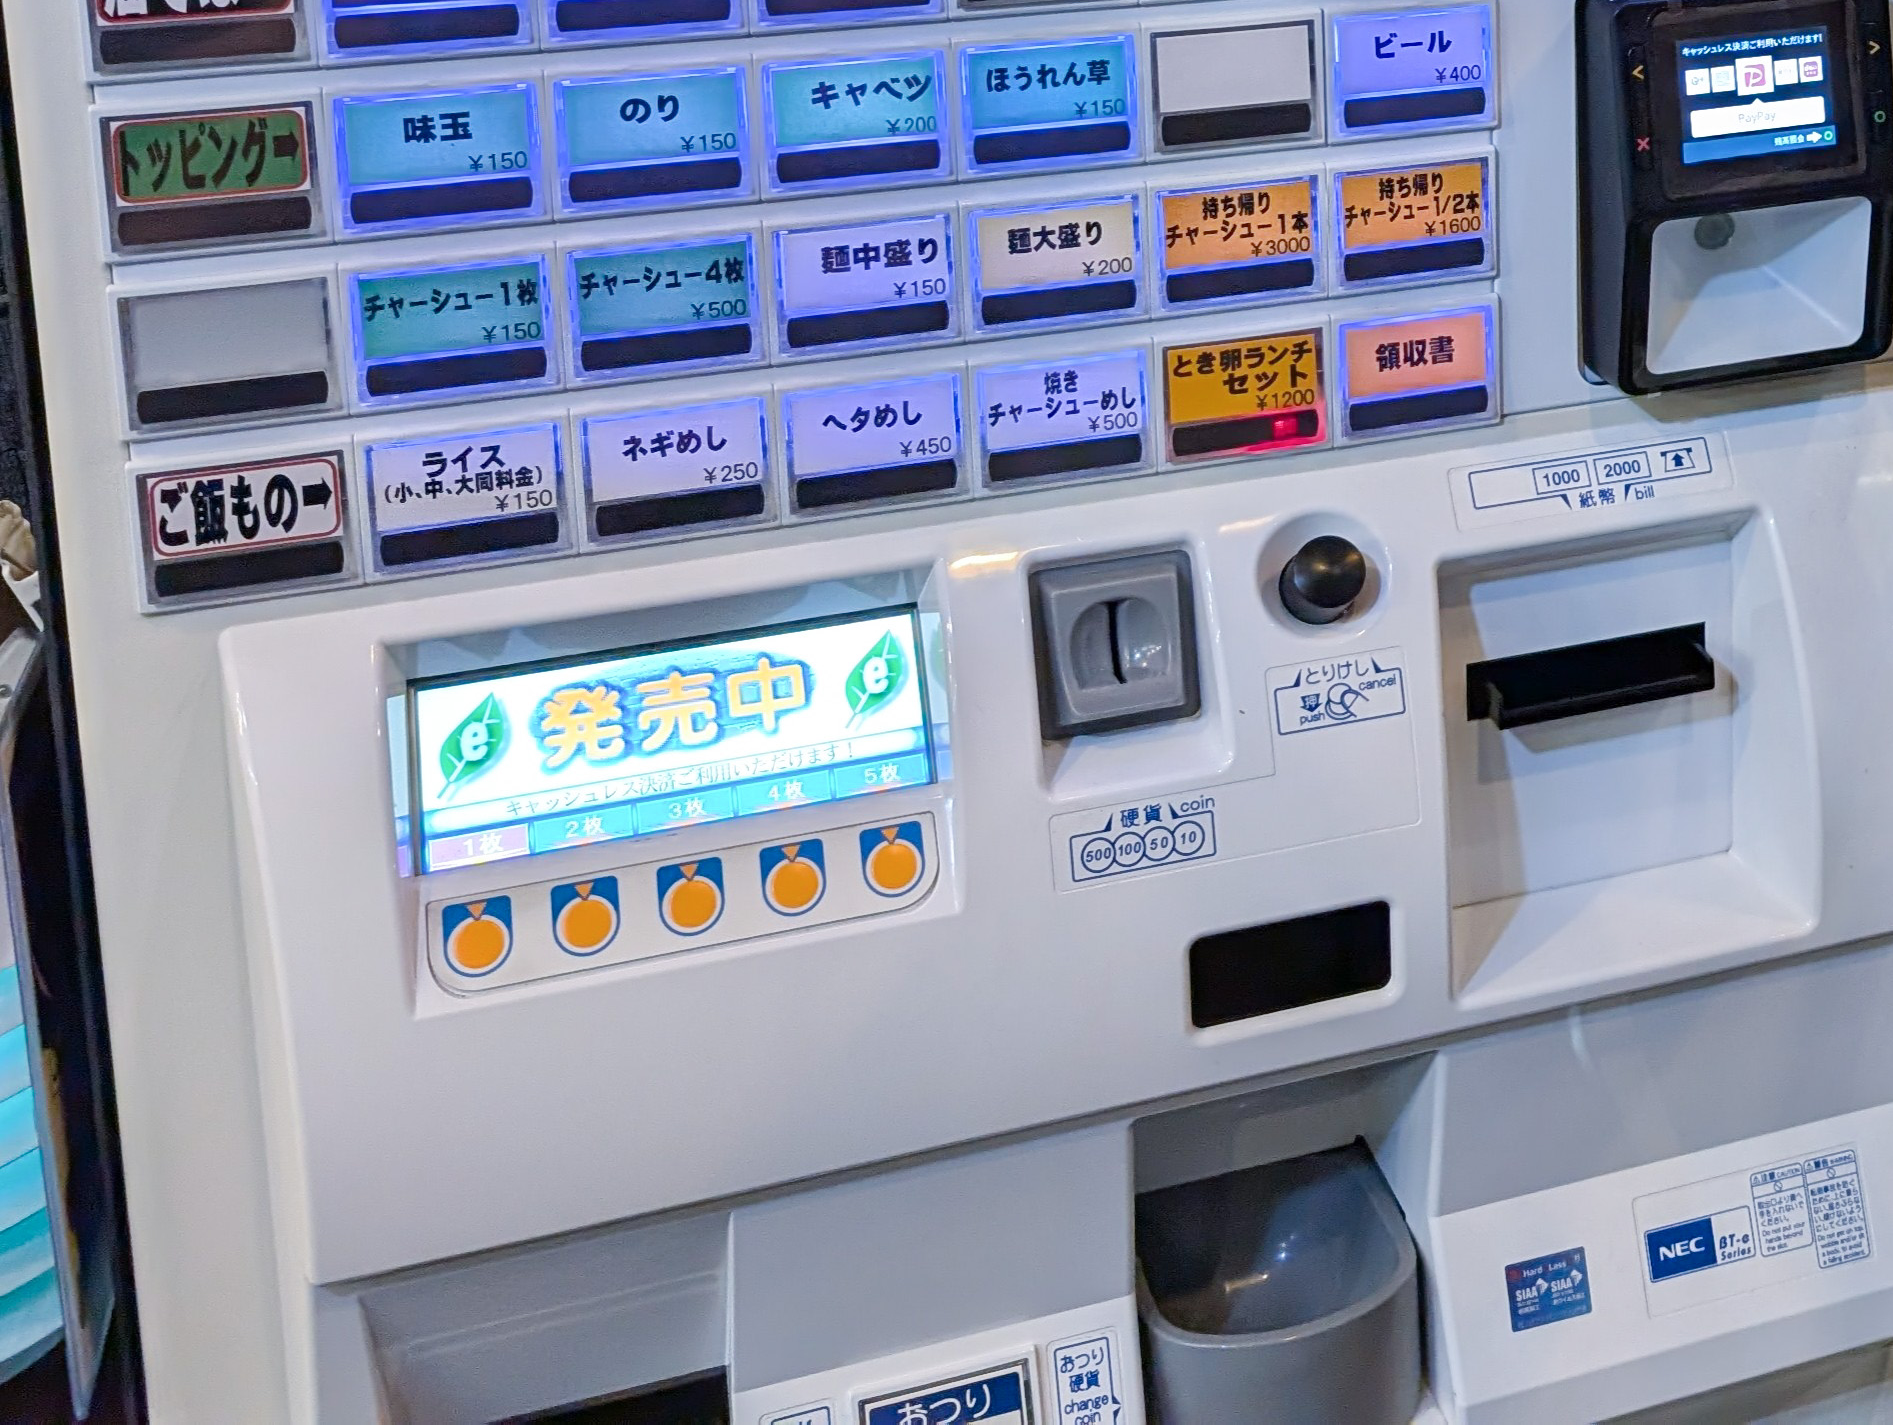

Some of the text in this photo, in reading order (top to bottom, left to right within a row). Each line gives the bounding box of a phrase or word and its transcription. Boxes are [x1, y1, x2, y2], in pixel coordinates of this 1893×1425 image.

[1374, 30, 1452, 59] ビール
[986, 59, 1111, 93] ほうれん草
[1435, 65, 1481, 84] ¥400
[811, 73, 932, 110] キャベツ
[619, 93, 680, 124] のり
[1738, 111, 1776, 124] PayPay
[402, 111, 474, 144] 味玉
[886, 115, 936, 136] ¥200
[119, 117, 268, 196] トッピング
[1378, 172, 1444, 201] 持ち帰り
[1344, 190, 1481, 229] チャーシュー1/2本
[1006, 220, 1103, 255] 麺大盛り
[1165, 211, 1309, 249] チャーシュー1本
[1424, 215, 1482, 237] ¥1600
[820, 238, 939, 275] 麺中盛り
[1250, 236, 1311, 257] ¥3000
[579, 256, 746, 299] チャーシュー4枚
[1081, 256, 1133, 277] ¥200
[363, 278, 538, 322] チャーシュー1枚
[893, 277, 946, 298] ¥150
[691, 298, 748, 320] ¥500
[1171, 339, 1313, 378] とき卵ランチ
[1375, 336, 1455, 372] 領収書
[1043, 369, 1079, 395] 焼き
[822, 399, 923, 433] ヘタめし
[988, 387, 1136, 428] チャーシューめし
[621, 424, 728, 460] ネギめし
[900, 436, 952, 458] ¥450
[421, 444, 506, 478] ライス
[703, 461, 758, 484] ¥250
[1542, 460, 1642, 486] 1000 2000
[1579, 486, 1616, 508] 紙幣
[1634, 485, 1655, 501] bill
[158, 473, 299, 548] ご飯もの
[1306, 659, 1369, 685] とりけし
[1359, 674, 1397, 691] cancel
[541, 657, 807, 770] 発売中
[1300, 711, 1325, 726] push
[505, 741, 855, 817] キャッシュレス決済ご利用いただけます！
[864, 762, 900, 784] 5枚
[768, 780, 805, 801] 4枚
[668, 798, 705, 819] 3枚
[1120, 803, 1162, 828] 硬貨
[1179, 795, 1215, 813] coin
[566, 815, 604, 838] 2枚
[463, 833, 504, 854] 1枚
[1086, 829, 1197, 862] 500 100 50 10
[1659, 1236, 1706, 1261] NEC
[1721, 1247, 1751, 1261] Series
[1059, 1347, 1104, 1374] おつり
[1064, 1395, 1109, 1415] change
